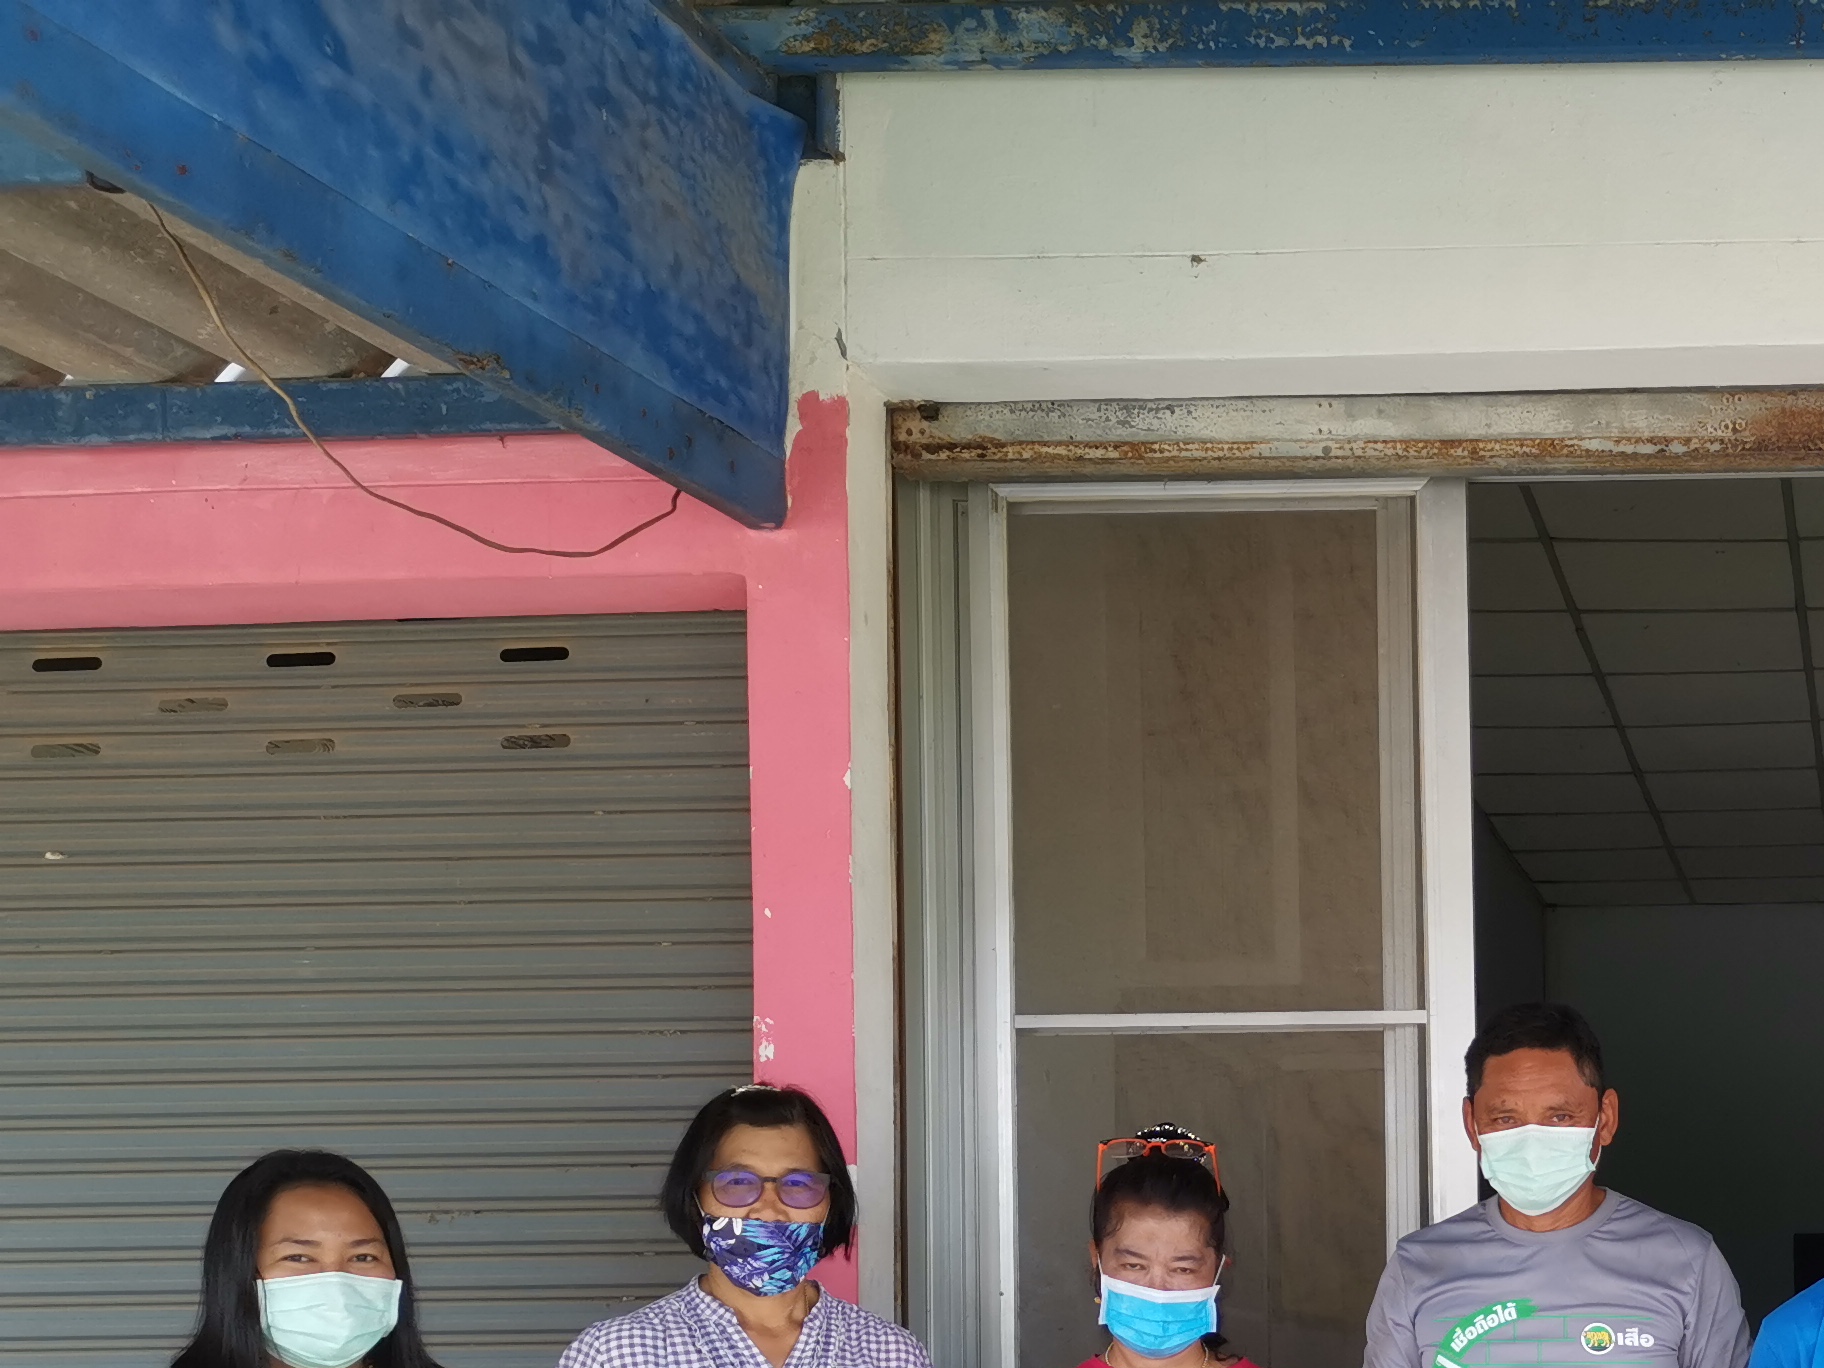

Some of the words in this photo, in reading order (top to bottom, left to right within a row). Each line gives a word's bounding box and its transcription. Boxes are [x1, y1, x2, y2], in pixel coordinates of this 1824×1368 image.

[1450, 1302, 1518, 1352] เชื่อถือได้
[1616, 1327, 1655, 1348] เสือ
